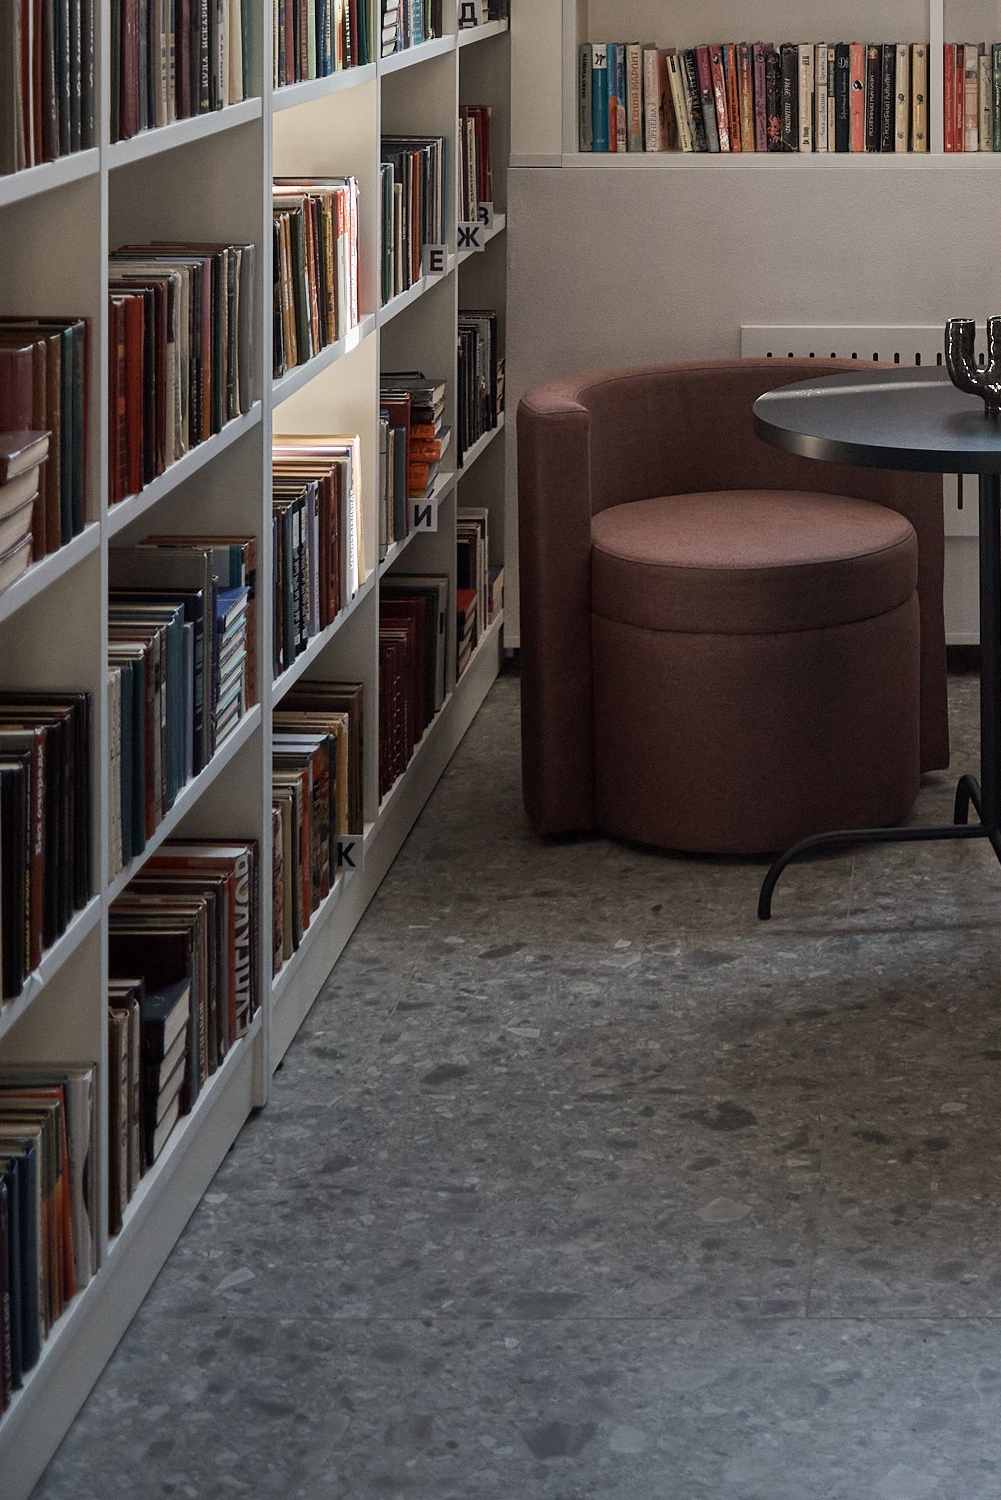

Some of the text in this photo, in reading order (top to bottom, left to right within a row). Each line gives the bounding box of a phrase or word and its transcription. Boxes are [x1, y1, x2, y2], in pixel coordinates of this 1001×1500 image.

[459, 2, 478, 28] Д
[630, 51, 639, 134] ЕВГЕНИЯ МАРЛИТ
[458, 225, 481, 248] Ж
[430, 250, 445, 272] Е
[413, 503, 433, 528] И
[338, 841, 357, 868] К
